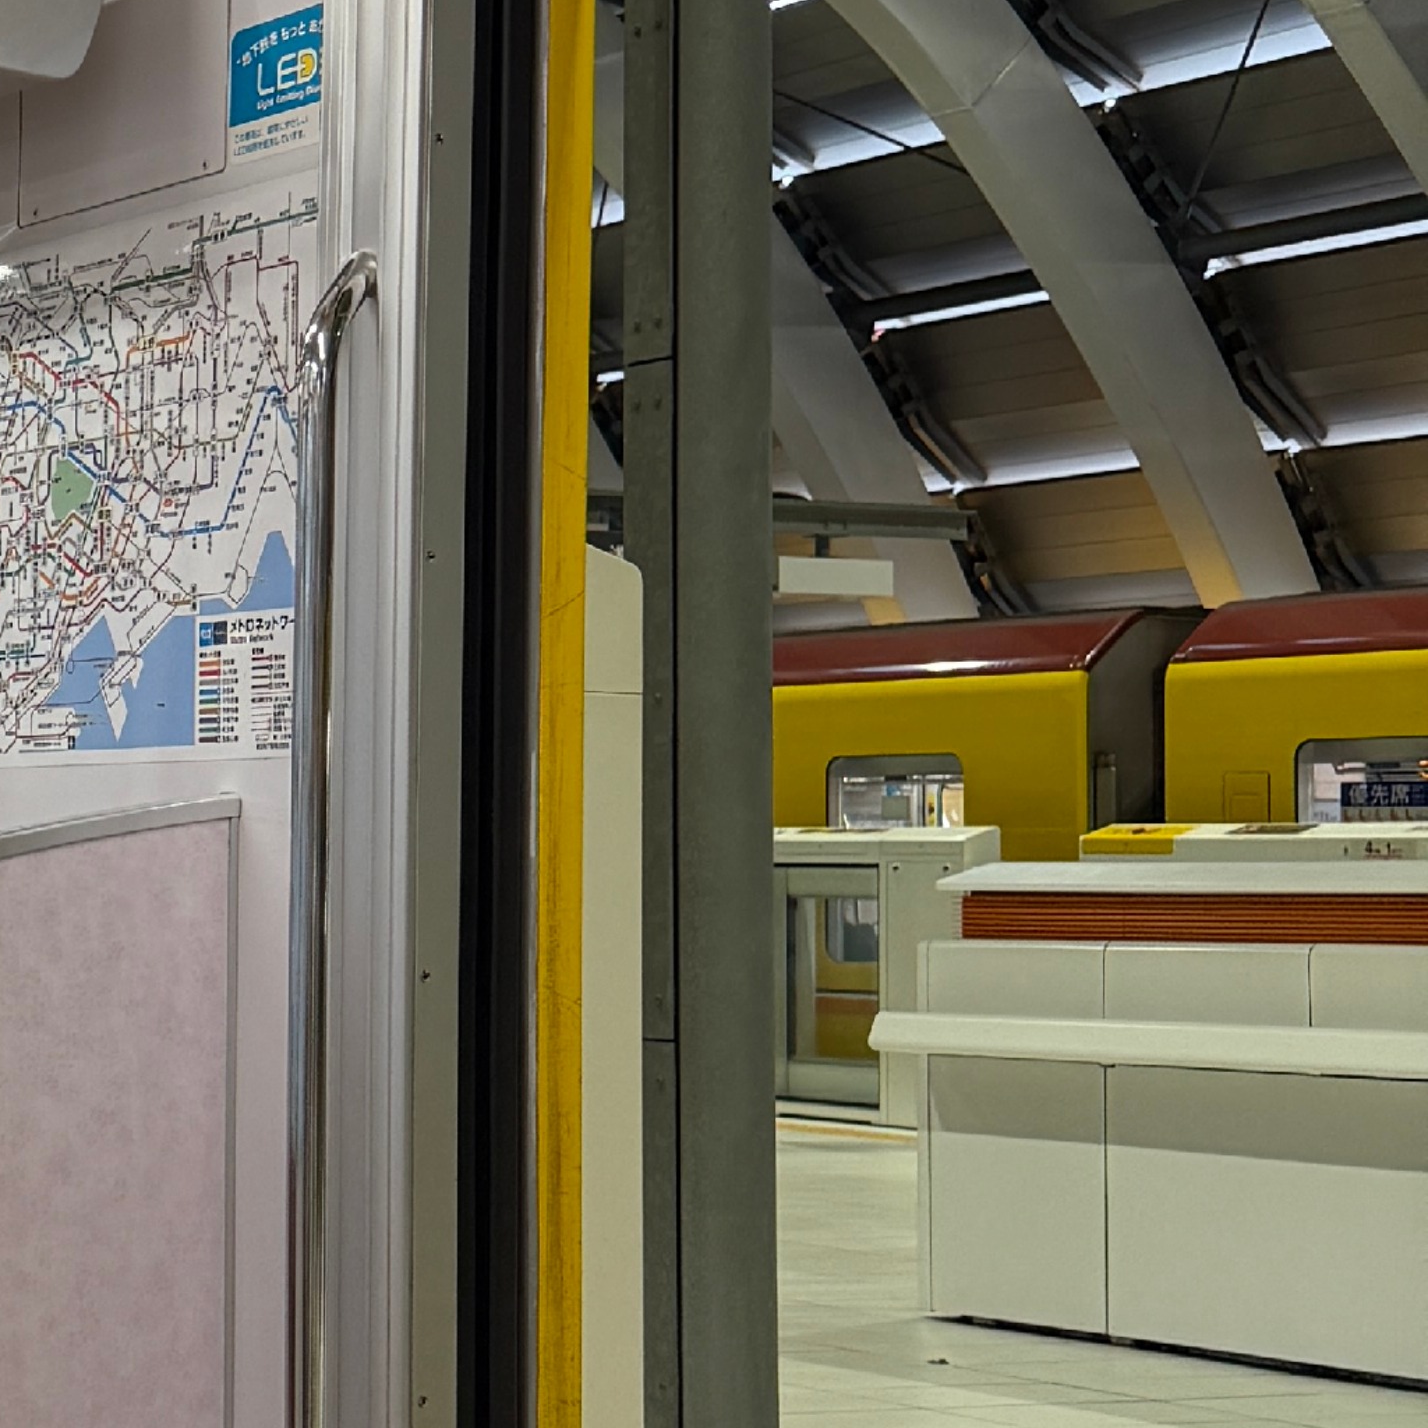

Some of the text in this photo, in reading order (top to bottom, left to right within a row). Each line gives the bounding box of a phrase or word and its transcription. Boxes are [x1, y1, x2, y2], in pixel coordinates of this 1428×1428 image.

[256, 46, 318, 97] LED
[1348, 783, 1410, 807] 優先席
